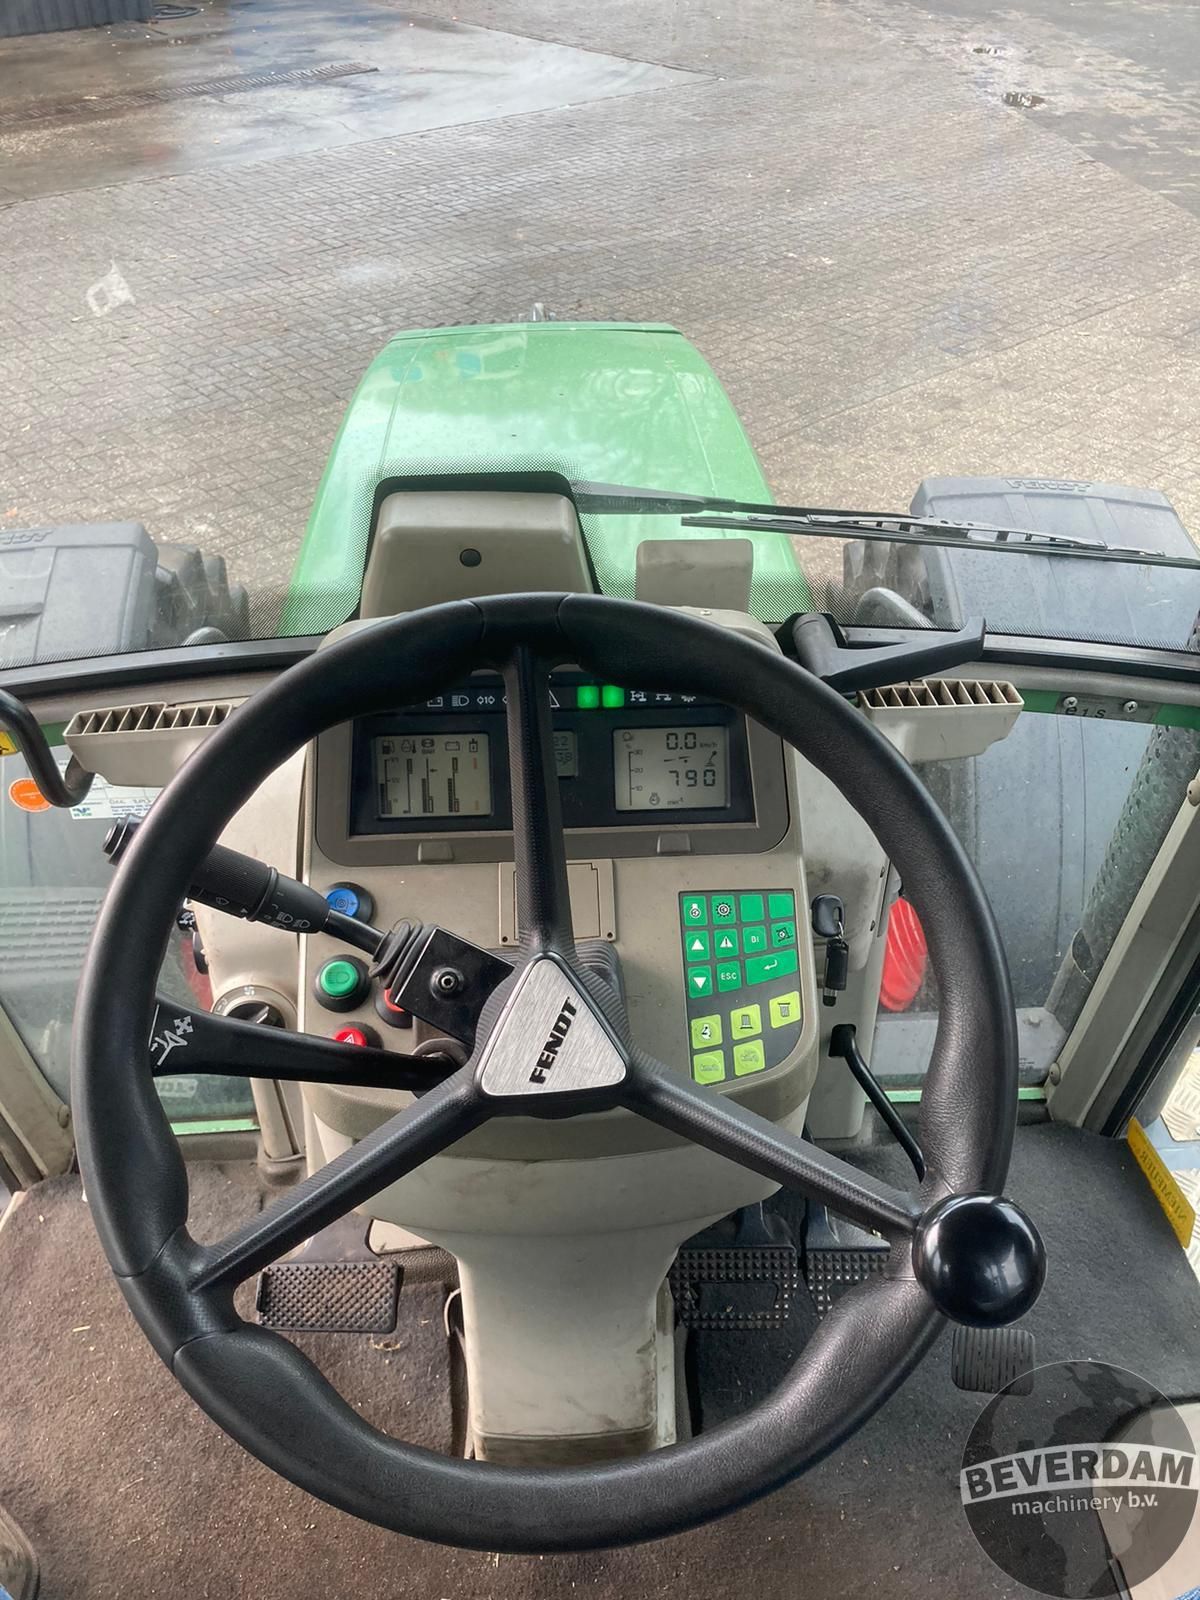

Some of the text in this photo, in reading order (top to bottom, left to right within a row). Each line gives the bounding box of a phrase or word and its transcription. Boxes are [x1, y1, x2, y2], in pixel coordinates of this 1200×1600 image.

[666, 732, 697, 750] 0.0
[668, 768, 716, 787] 790
[720, 970, 737, 981] ESC
[528, 996, 577, 1085] FENDT
